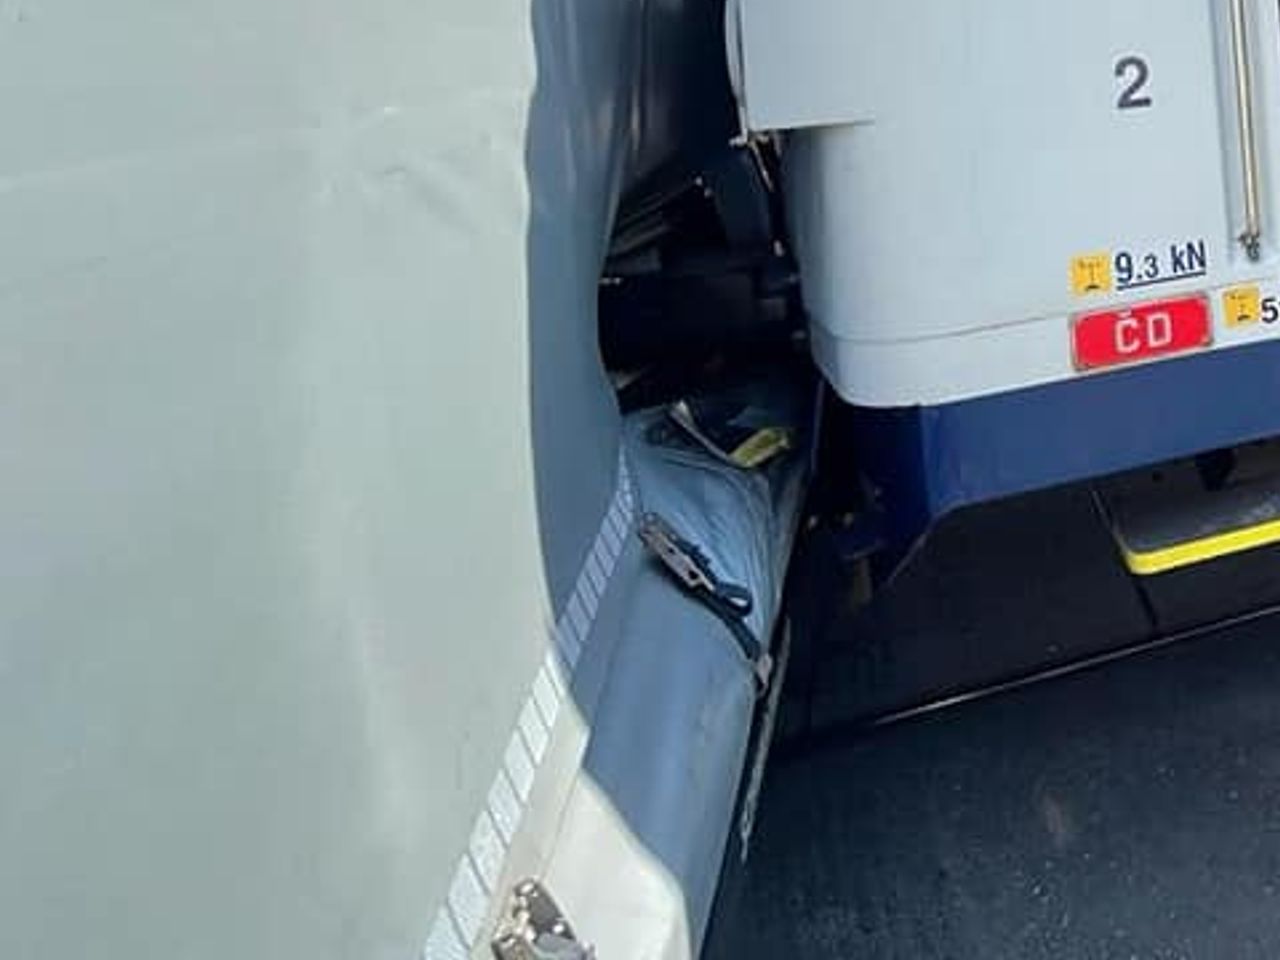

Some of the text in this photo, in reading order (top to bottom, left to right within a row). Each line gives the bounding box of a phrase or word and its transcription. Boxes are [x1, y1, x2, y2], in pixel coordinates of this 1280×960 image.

[1113, 56, 1152, 110] 2
[1115, 240, 1207, 283] 9.3 kN
